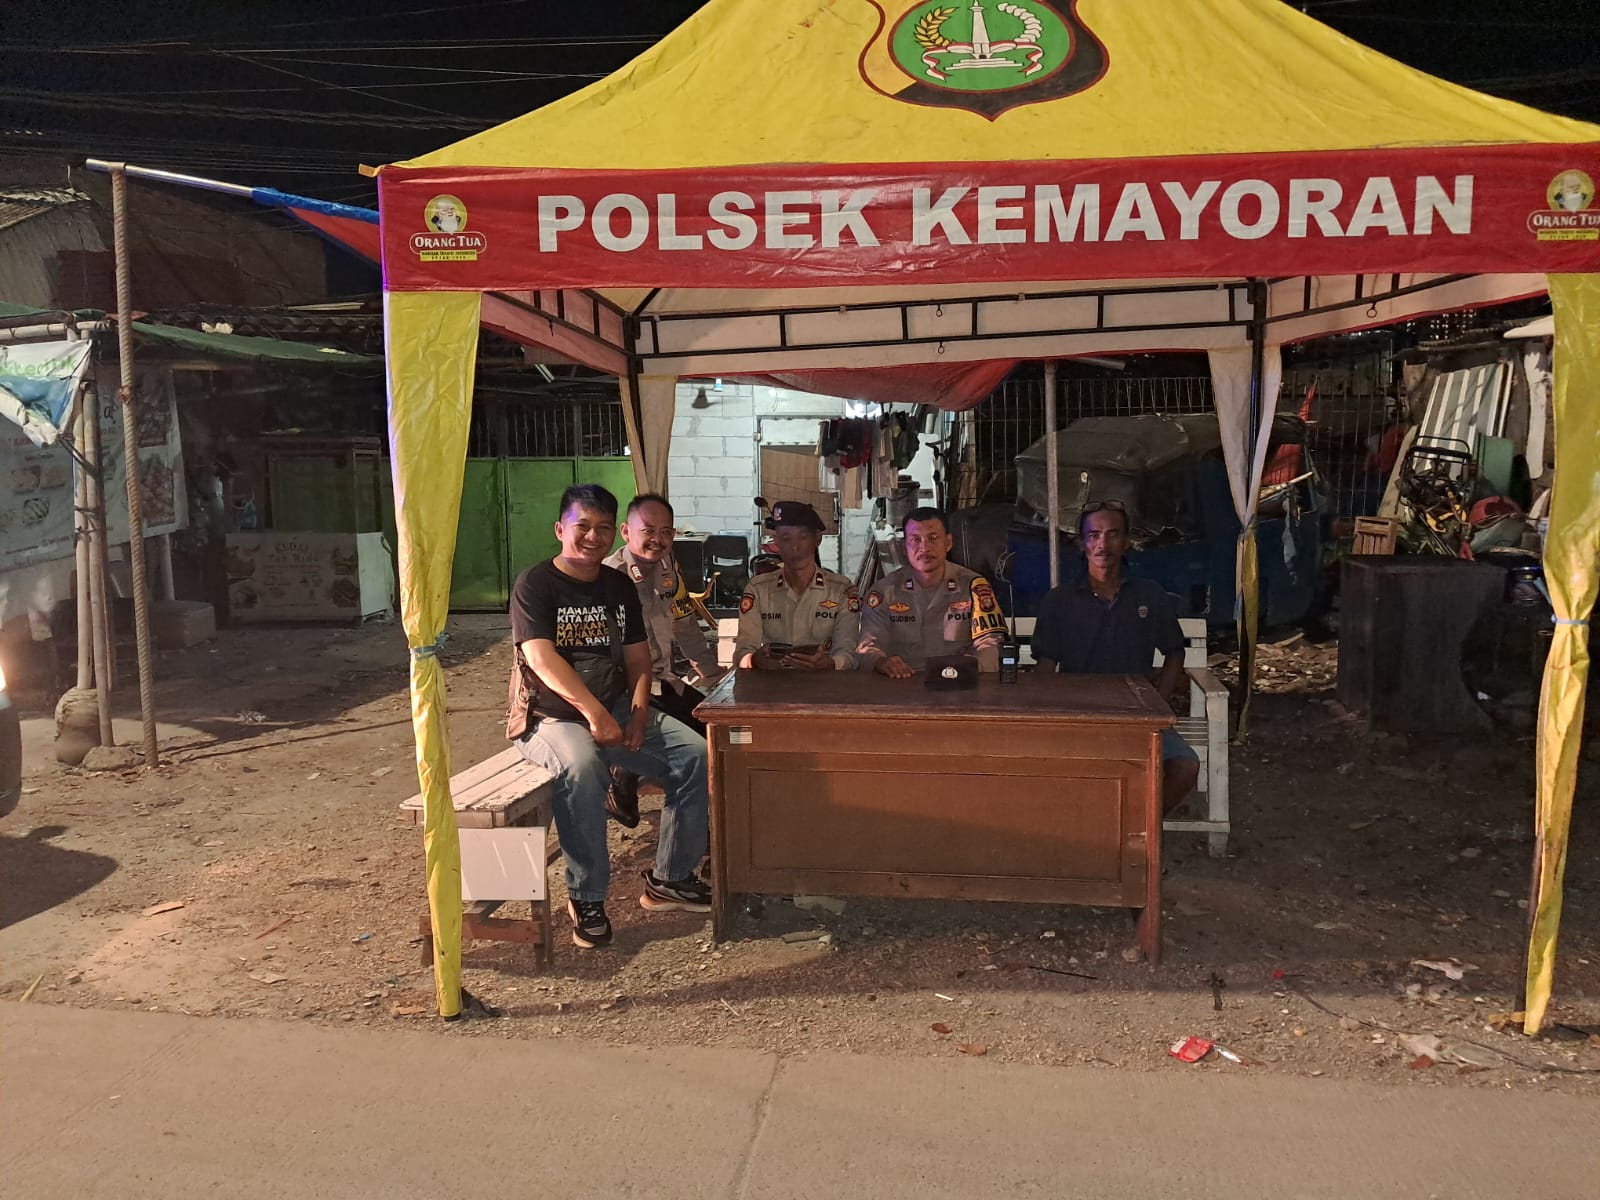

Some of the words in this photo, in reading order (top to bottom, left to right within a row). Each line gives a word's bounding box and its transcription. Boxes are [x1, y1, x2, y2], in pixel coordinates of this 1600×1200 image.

[537, 188, 881, 254] POLSEK
[911, 173, 1474, 248] KEMAYORAN
[1533, 214, 1577, 227] ORANG
[415, 236, 456, 248] ORANG
[457, 235, 481, 247] TUA
